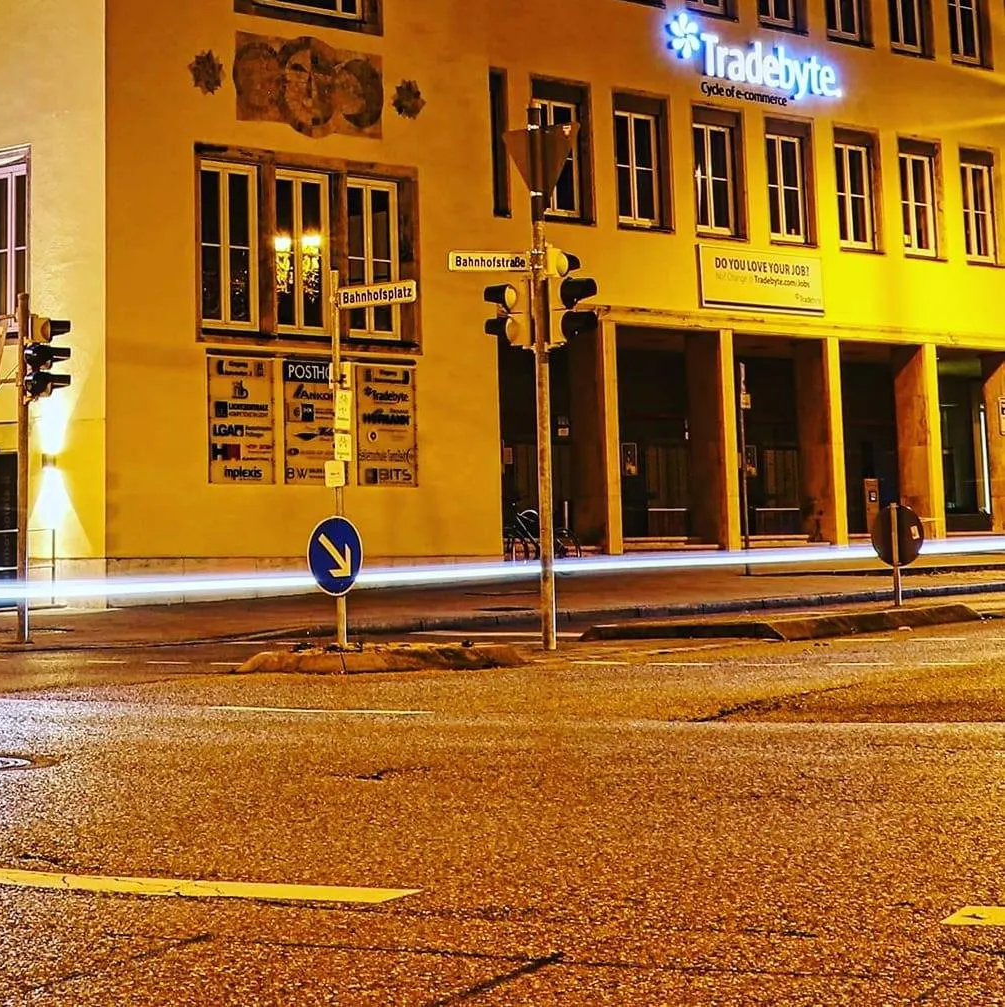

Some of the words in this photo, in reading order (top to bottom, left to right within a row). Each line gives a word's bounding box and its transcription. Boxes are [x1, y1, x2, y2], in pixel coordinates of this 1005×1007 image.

[700, 81, 724, 97] Cycle
[725, 86, 735, 98] of
[736, 90, 788, 107] e-commerce
[455, 255, 526, 268] Bahnhofstraße
[715, 257, 727, 269] DO
[729, 259, 746, 271] YOU
[747, 260, 768, 273] LOVE
[768, 262, 791, 275] YOUR
[343, 286, 412, 304] Bahnhofsplatz
[224, 465, 263, 480] implexis
